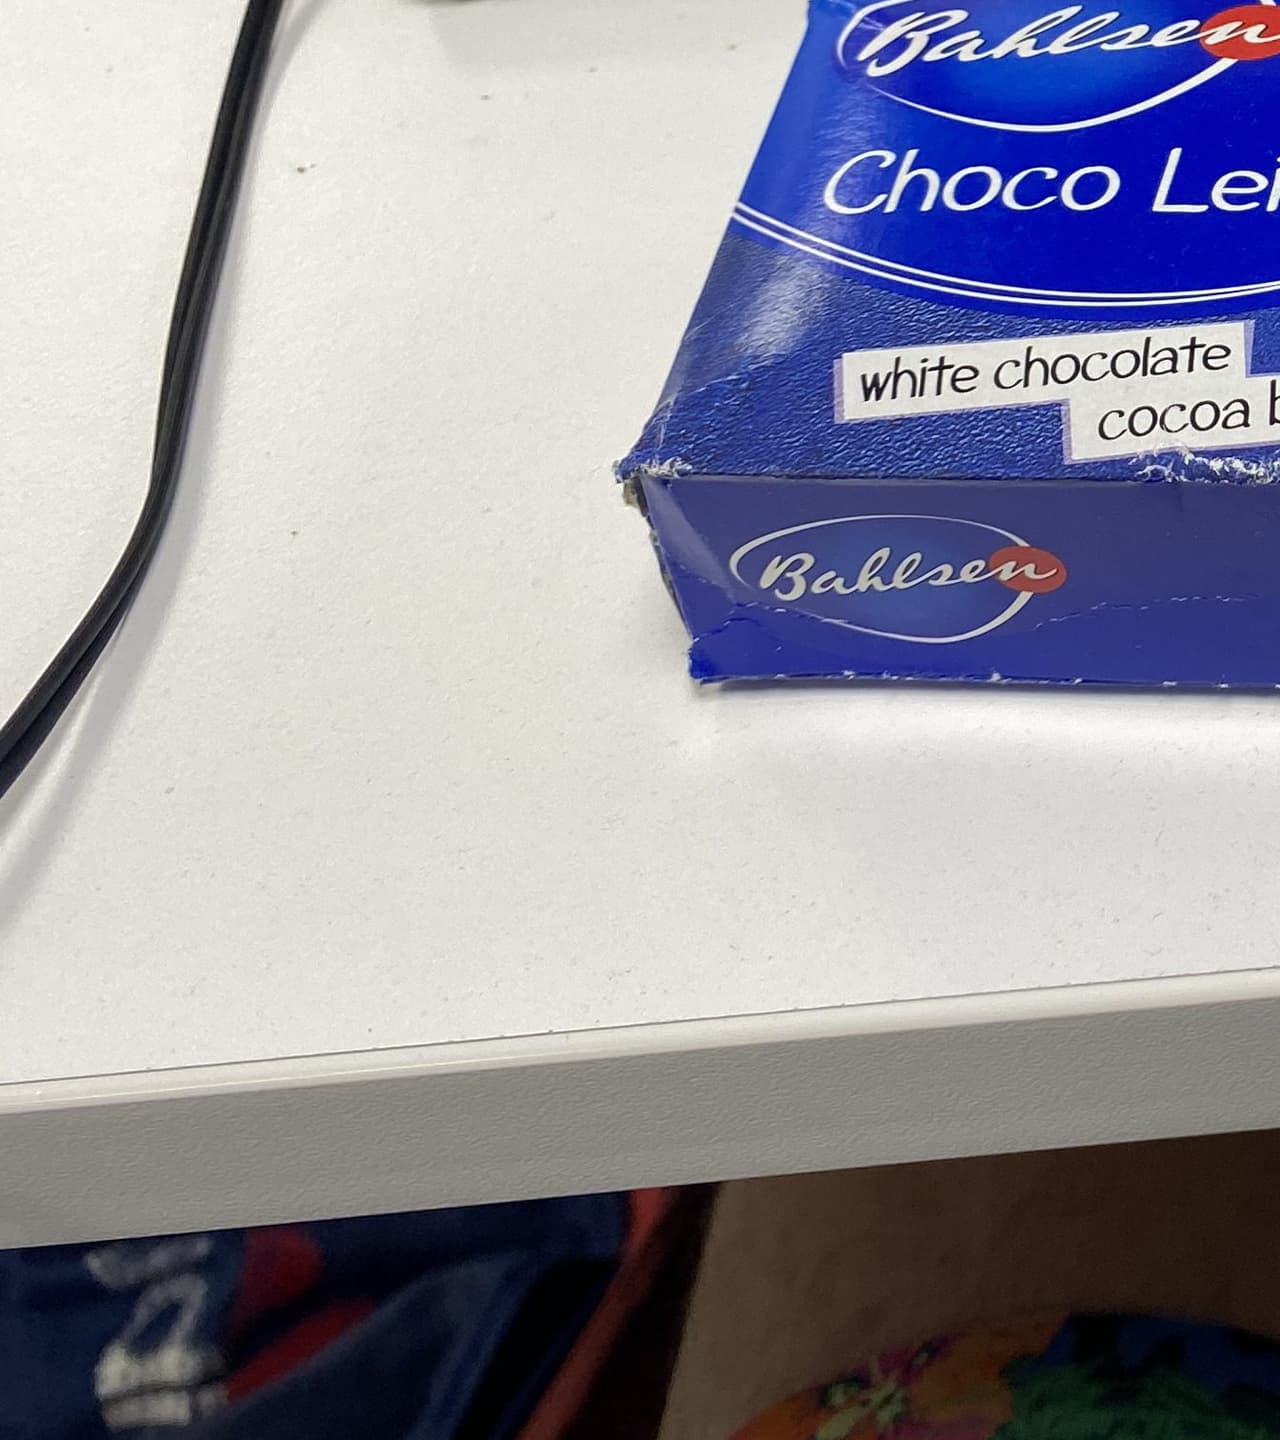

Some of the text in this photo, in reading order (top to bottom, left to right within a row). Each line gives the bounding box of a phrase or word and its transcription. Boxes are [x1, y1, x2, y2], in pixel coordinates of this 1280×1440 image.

[823, 148, 1120, 214] Choco
[860, 337, 1231, 402] white chocolate
[1098, 397, 1251, 441] cocoa
[759, 545, 1059, 601] Bahlsen
